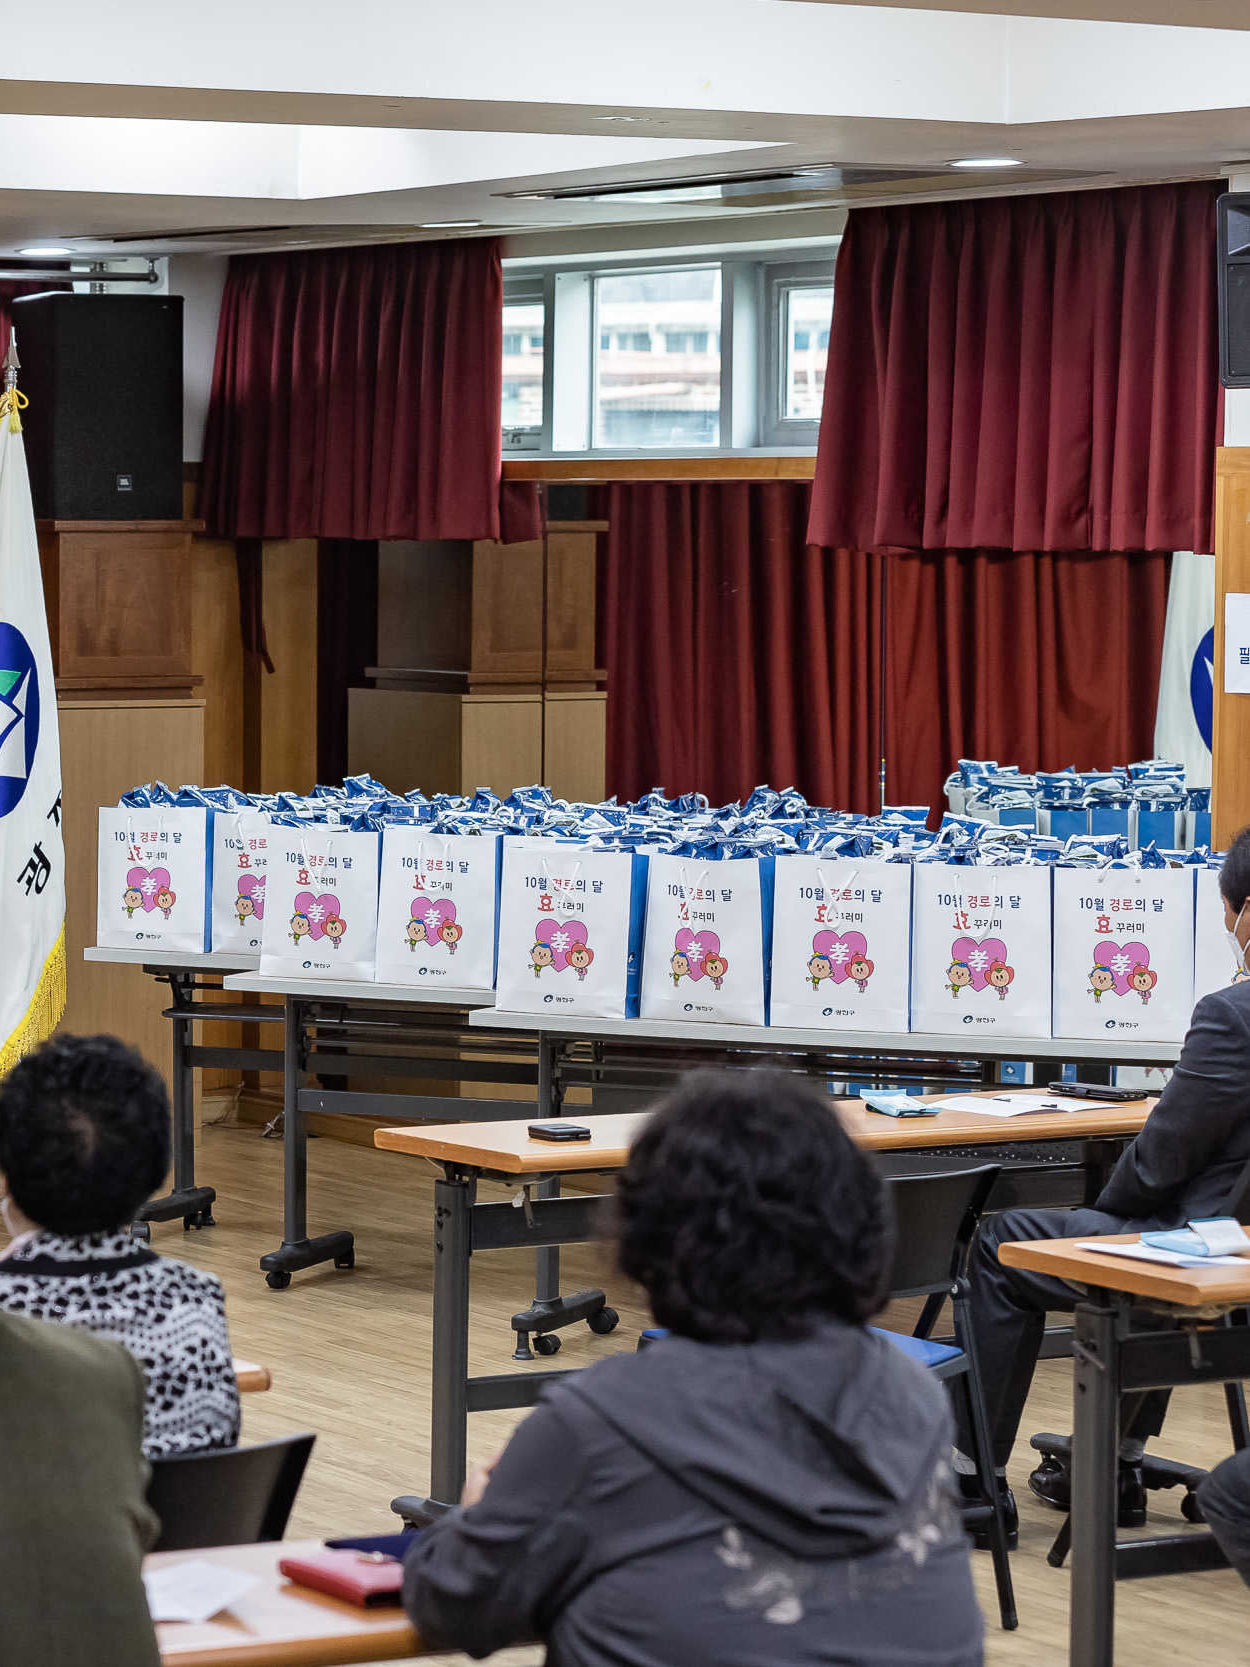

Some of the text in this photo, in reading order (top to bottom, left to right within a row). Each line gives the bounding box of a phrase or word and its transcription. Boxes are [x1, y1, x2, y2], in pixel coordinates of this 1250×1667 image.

[140, 831, 168, 843] 경로의
[173, 832, 183, 844] 달
[237, 852, 252, 868] 효
[285, 852, 305, 866] 10월
[342, 857, 353, 869] 달
[425, 859, 454, 873] 경로의
[459, 861, 470, 874] 달
[296, 868, 311, 885] 효
[524, 876, 548, 891] 10월
[592, 880, 604, 893] 달
[141, 877, 158, 896] 孝
[721, 889, 733, 902] 달
[799, 887, 824, 901] 10월
[870, 889, 883, 903] 달
[537, 893, 555, 912] 효
[967, 895, 1003, 909] 경로의
[1009, 895, 1022, 909] 달
[1079, 897, 1165, 913] 10월 경로의 달
[308, 903, 326, 923] 孝
[424, 908, 442, 929] 孝
[691, 911, 715, 922] 꾸러미
[952, 911, 971, 930] 효
[1094, 914, 1145, 934] 효 꾸러미
[550, 931, 571, 953] 孝
[687, 941, 704, 963] 孝
[829, 942, 850, 965] 孝
[968, 949, 989, 972] 孝
[1111, 953, 1132, 976] 孝
